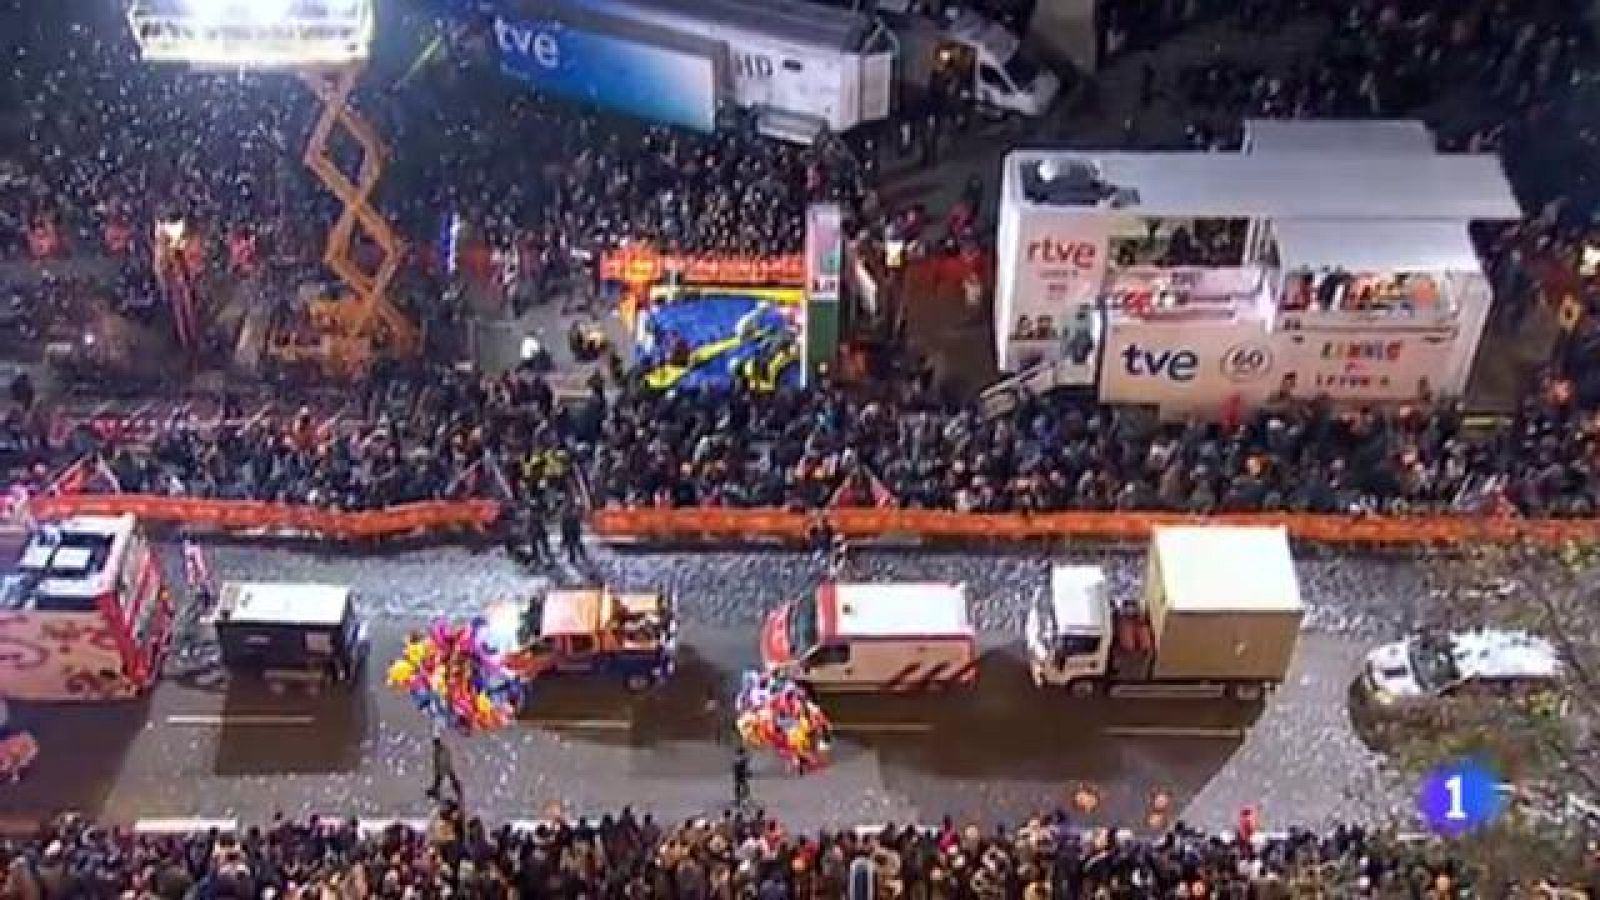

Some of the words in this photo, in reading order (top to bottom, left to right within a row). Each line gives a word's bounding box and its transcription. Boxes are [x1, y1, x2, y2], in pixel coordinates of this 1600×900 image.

[494, 15, 560, 68] tve
[1027, 236, 1096, 270] rtve
[1122, 344, 1198, 382] tve
